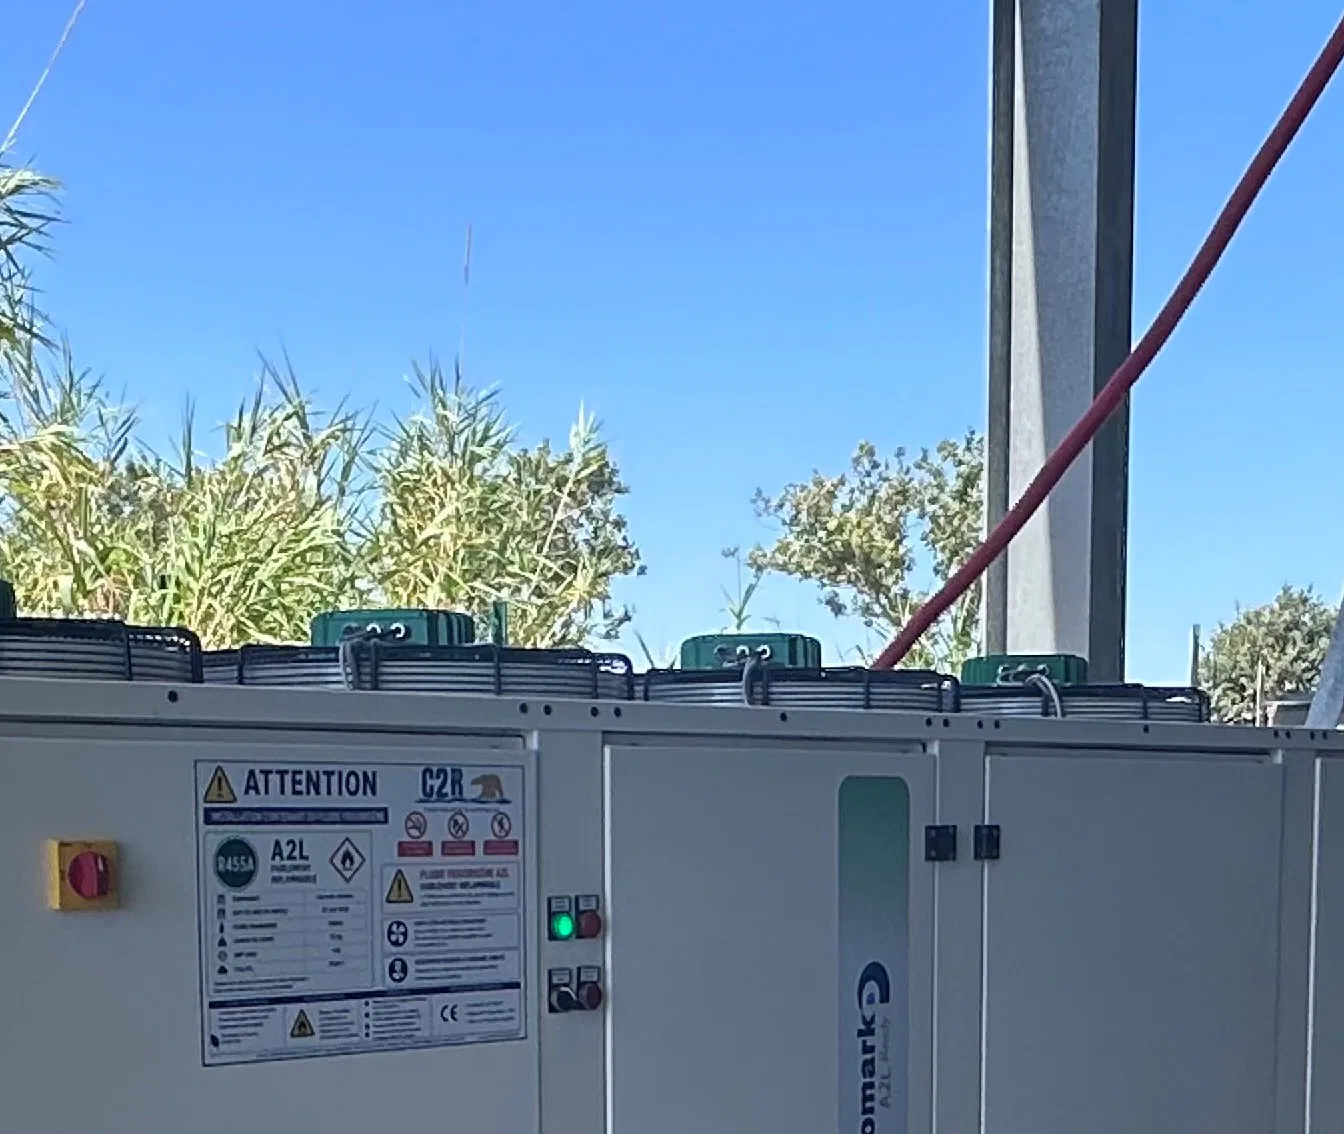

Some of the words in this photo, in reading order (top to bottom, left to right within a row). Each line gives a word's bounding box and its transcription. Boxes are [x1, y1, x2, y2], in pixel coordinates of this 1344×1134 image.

[243, 769, 377, 797] ATTENTION
[422, 767, 464, 799] C2R
[271, 838, 310, 862] A2L
